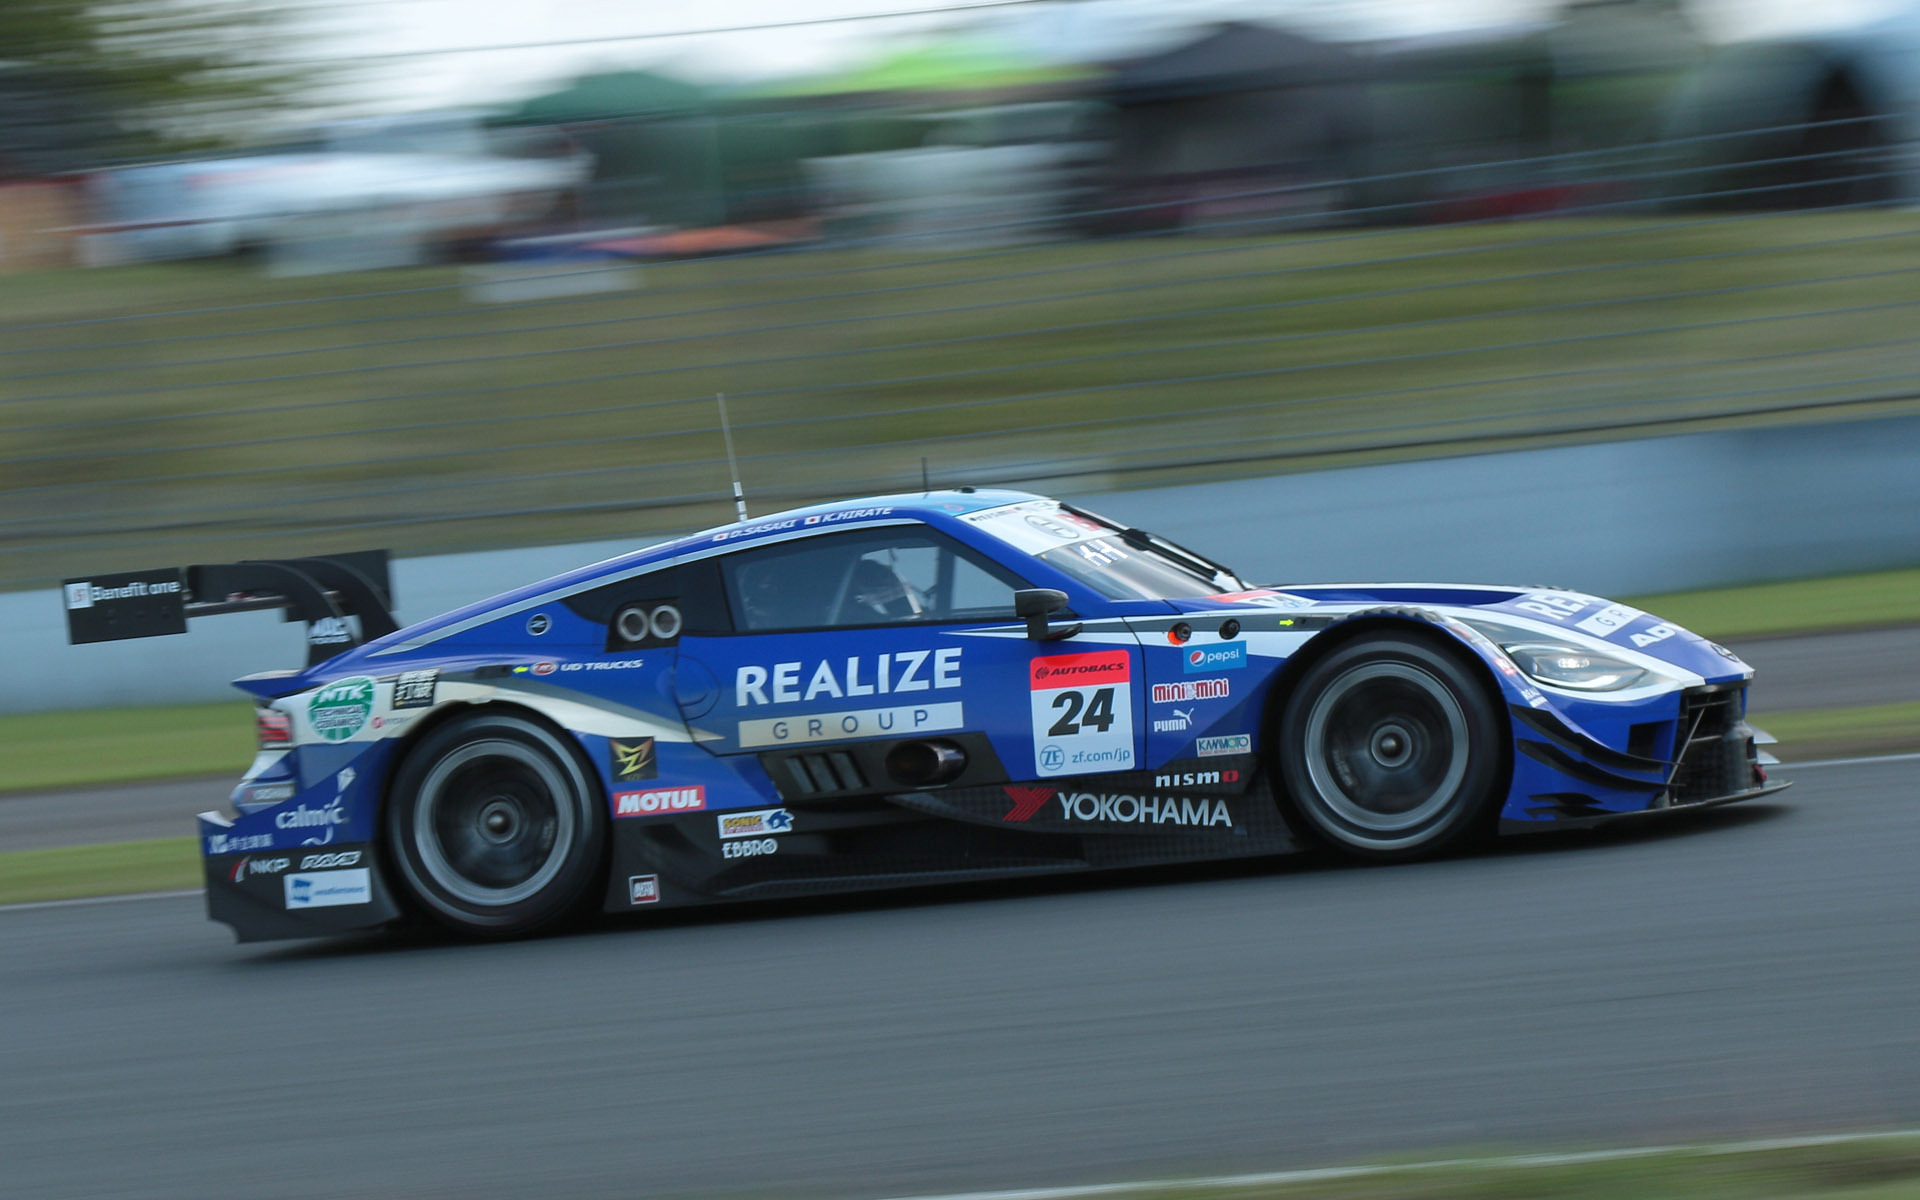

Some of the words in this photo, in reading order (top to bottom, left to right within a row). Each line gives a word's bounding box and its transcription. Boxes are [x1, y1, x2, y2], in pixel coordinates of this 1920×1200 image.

[822, 507, 893, 523] K.HIRATE
[91, 582, 148, 601] Benefit
[149, 582, 180, 595] one
[561, 663, 582, 671] UD
[584, 660, 643, 670] TRUCKS
[1207, 649, 1239, 663] pepsi
[736, 648, 962, 706] REALIZE
[1051, 662, 1124, 676] AUTOBACS
[1048, 688, 1115, 737] 24
[773, 709, 928, 740] GROUP
[1072, 748, 1130, 764] zf.com/jp
[617, 789, 701, 814] MOTUL
[1057, 792, 1232, 827] YOKOHAMA
[275, 804, 345, 829] calmic
[723, 815, 762, 828] SONIC
[722, 838, 778, 859] EBBRO
